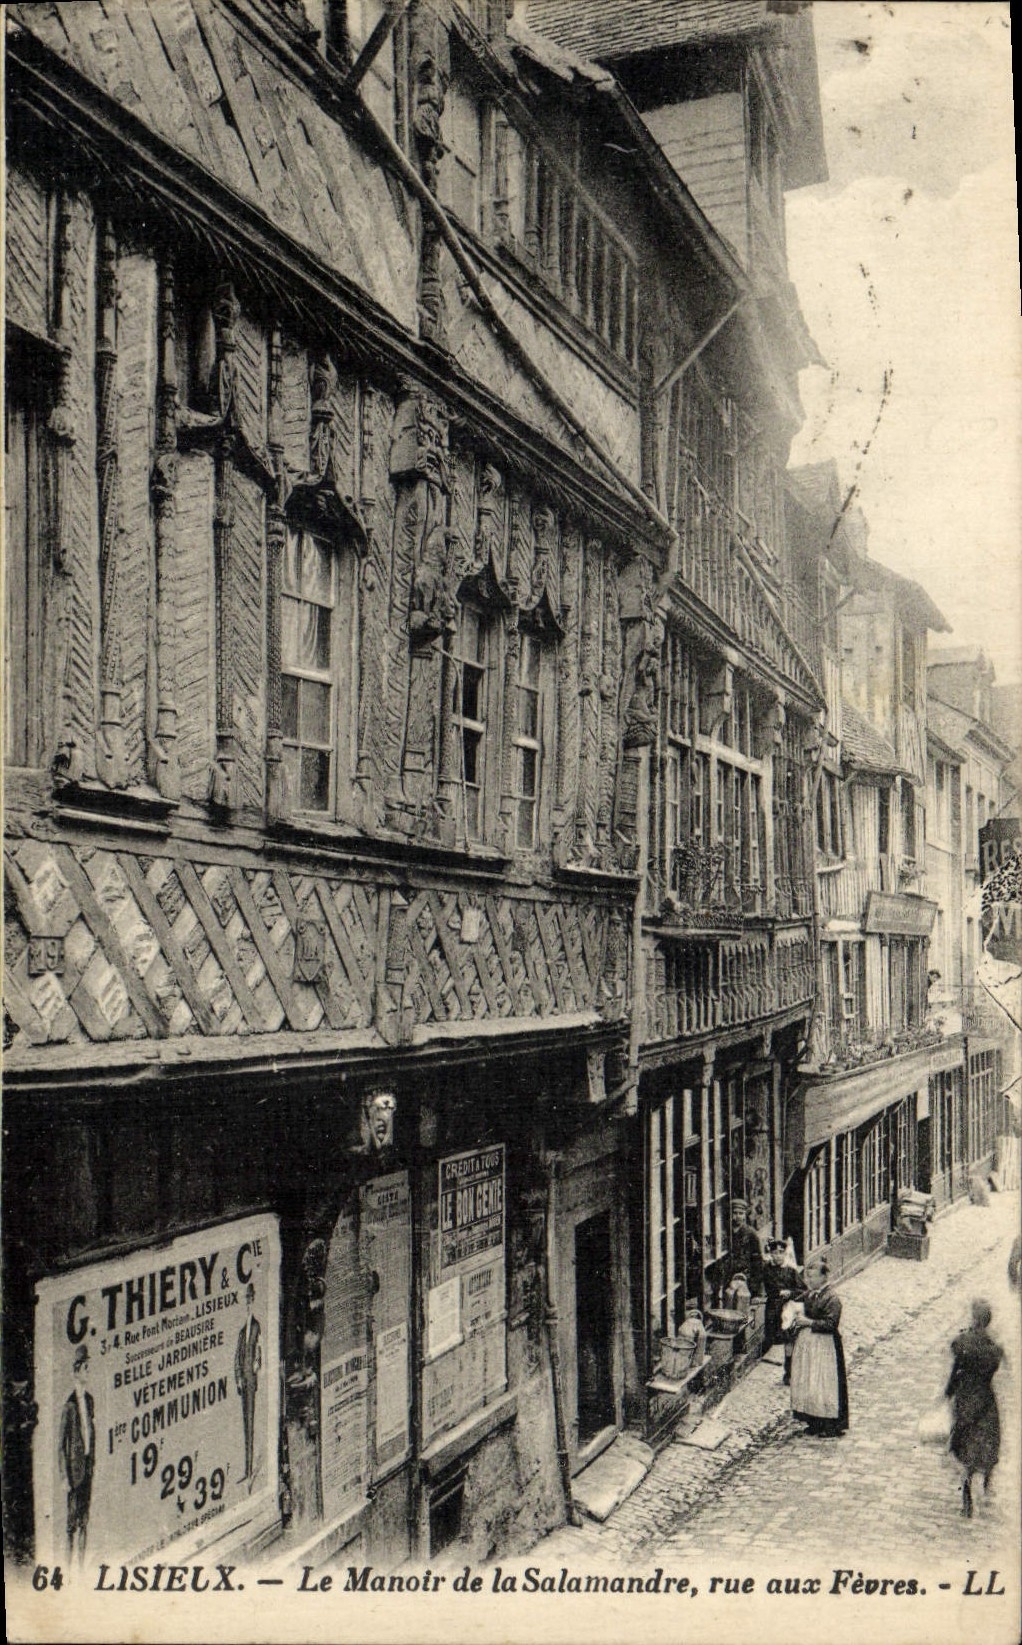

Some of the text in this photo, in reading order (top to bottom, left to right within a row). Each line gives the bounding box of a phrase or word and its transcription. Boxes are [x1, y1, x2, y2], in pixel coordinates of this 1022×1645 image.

[442, 1192, 453, 1232] LE
[456, 1186, 475, 1227] BON
[66, 1295, 97, 1345] G.
[220, 1266, 230, 1290] &
[124, 1331, 140, 1346] Rue
[142, 1321, 160, 1340] Pont
[195, 1291, 239, 1319] LISIEUX
[174, 1317, 215, 1345] BEAUSIRE
[113, 1330, 225, 1389] BELLE JARDINIÈRE
[130, 1375, 228, 1444] COMMUNION
